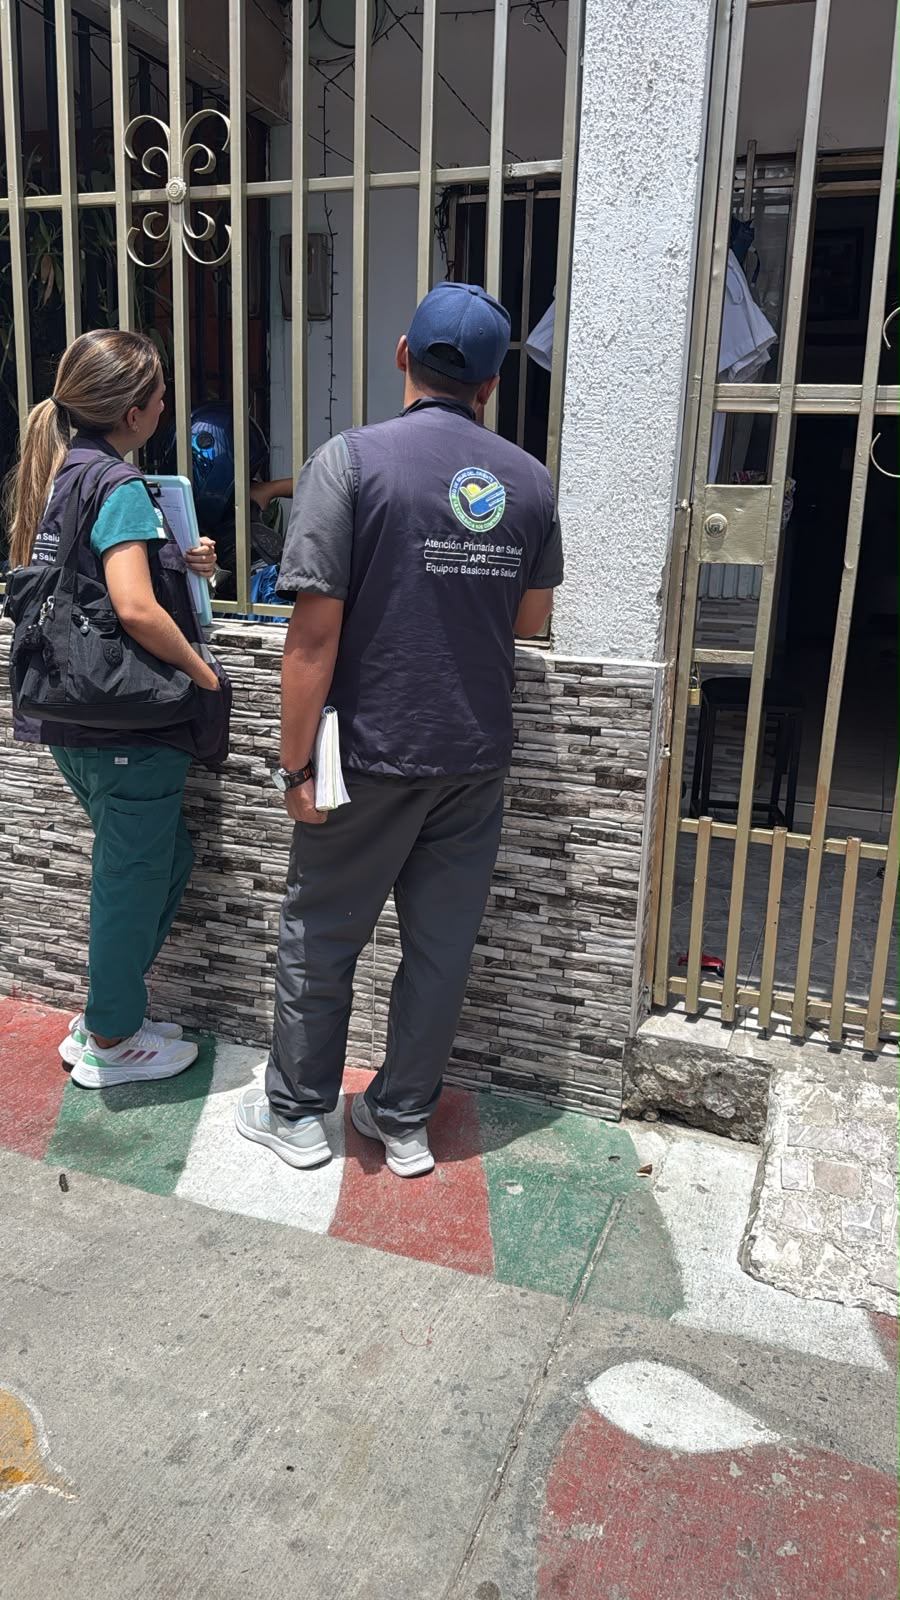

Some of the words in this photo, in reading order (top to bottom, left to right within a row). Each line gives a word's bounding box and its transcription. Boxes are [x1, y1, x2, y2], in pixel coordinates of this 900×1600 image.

[43, 532, 60, 542] Salu
[424, 538, 461, 549] Atención
[506, 546, 523, 555] Salud
[39, 552, 56, 562] Salu
[470, 554, 486, 563] APS
[425, 563, 459, 574] Equipos
[460, 565, 490, 575] Basicos
[491, 567, 499, 576] de
[500, 568, 517, 578] Salud
